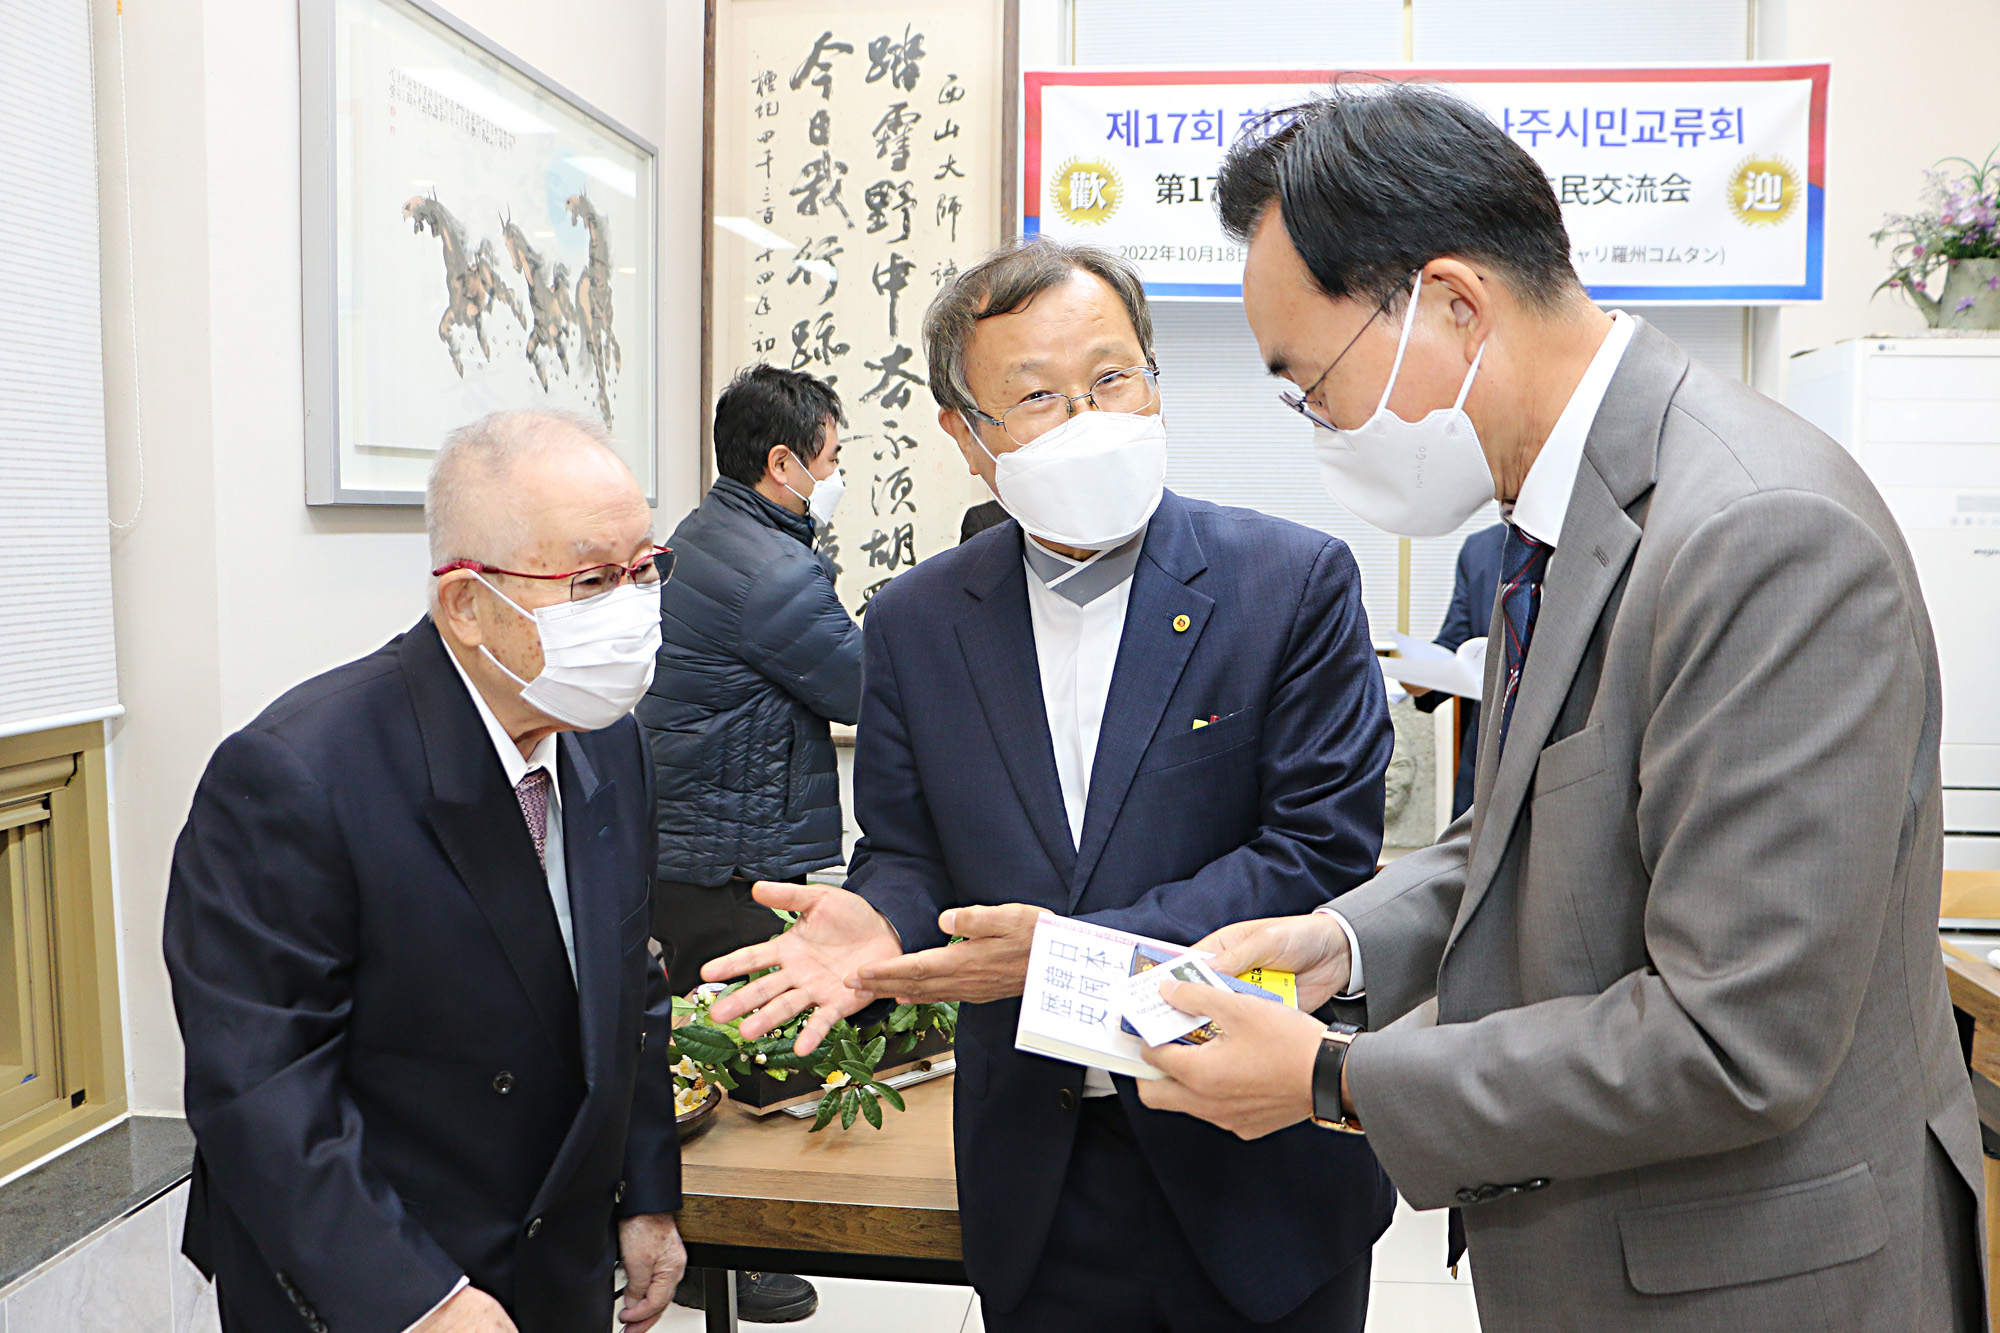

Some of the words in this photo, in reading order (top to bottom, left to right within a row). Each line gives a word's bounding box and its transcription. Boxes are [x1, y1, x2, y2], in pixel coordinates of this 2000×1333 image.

[1106, 108, 1223, 148] 제17회
[1068, 171, 1107, 211] 歡
[1551, 172, 1692, 205] 民交流会
[1741, 170, 1783, 212] 迎
